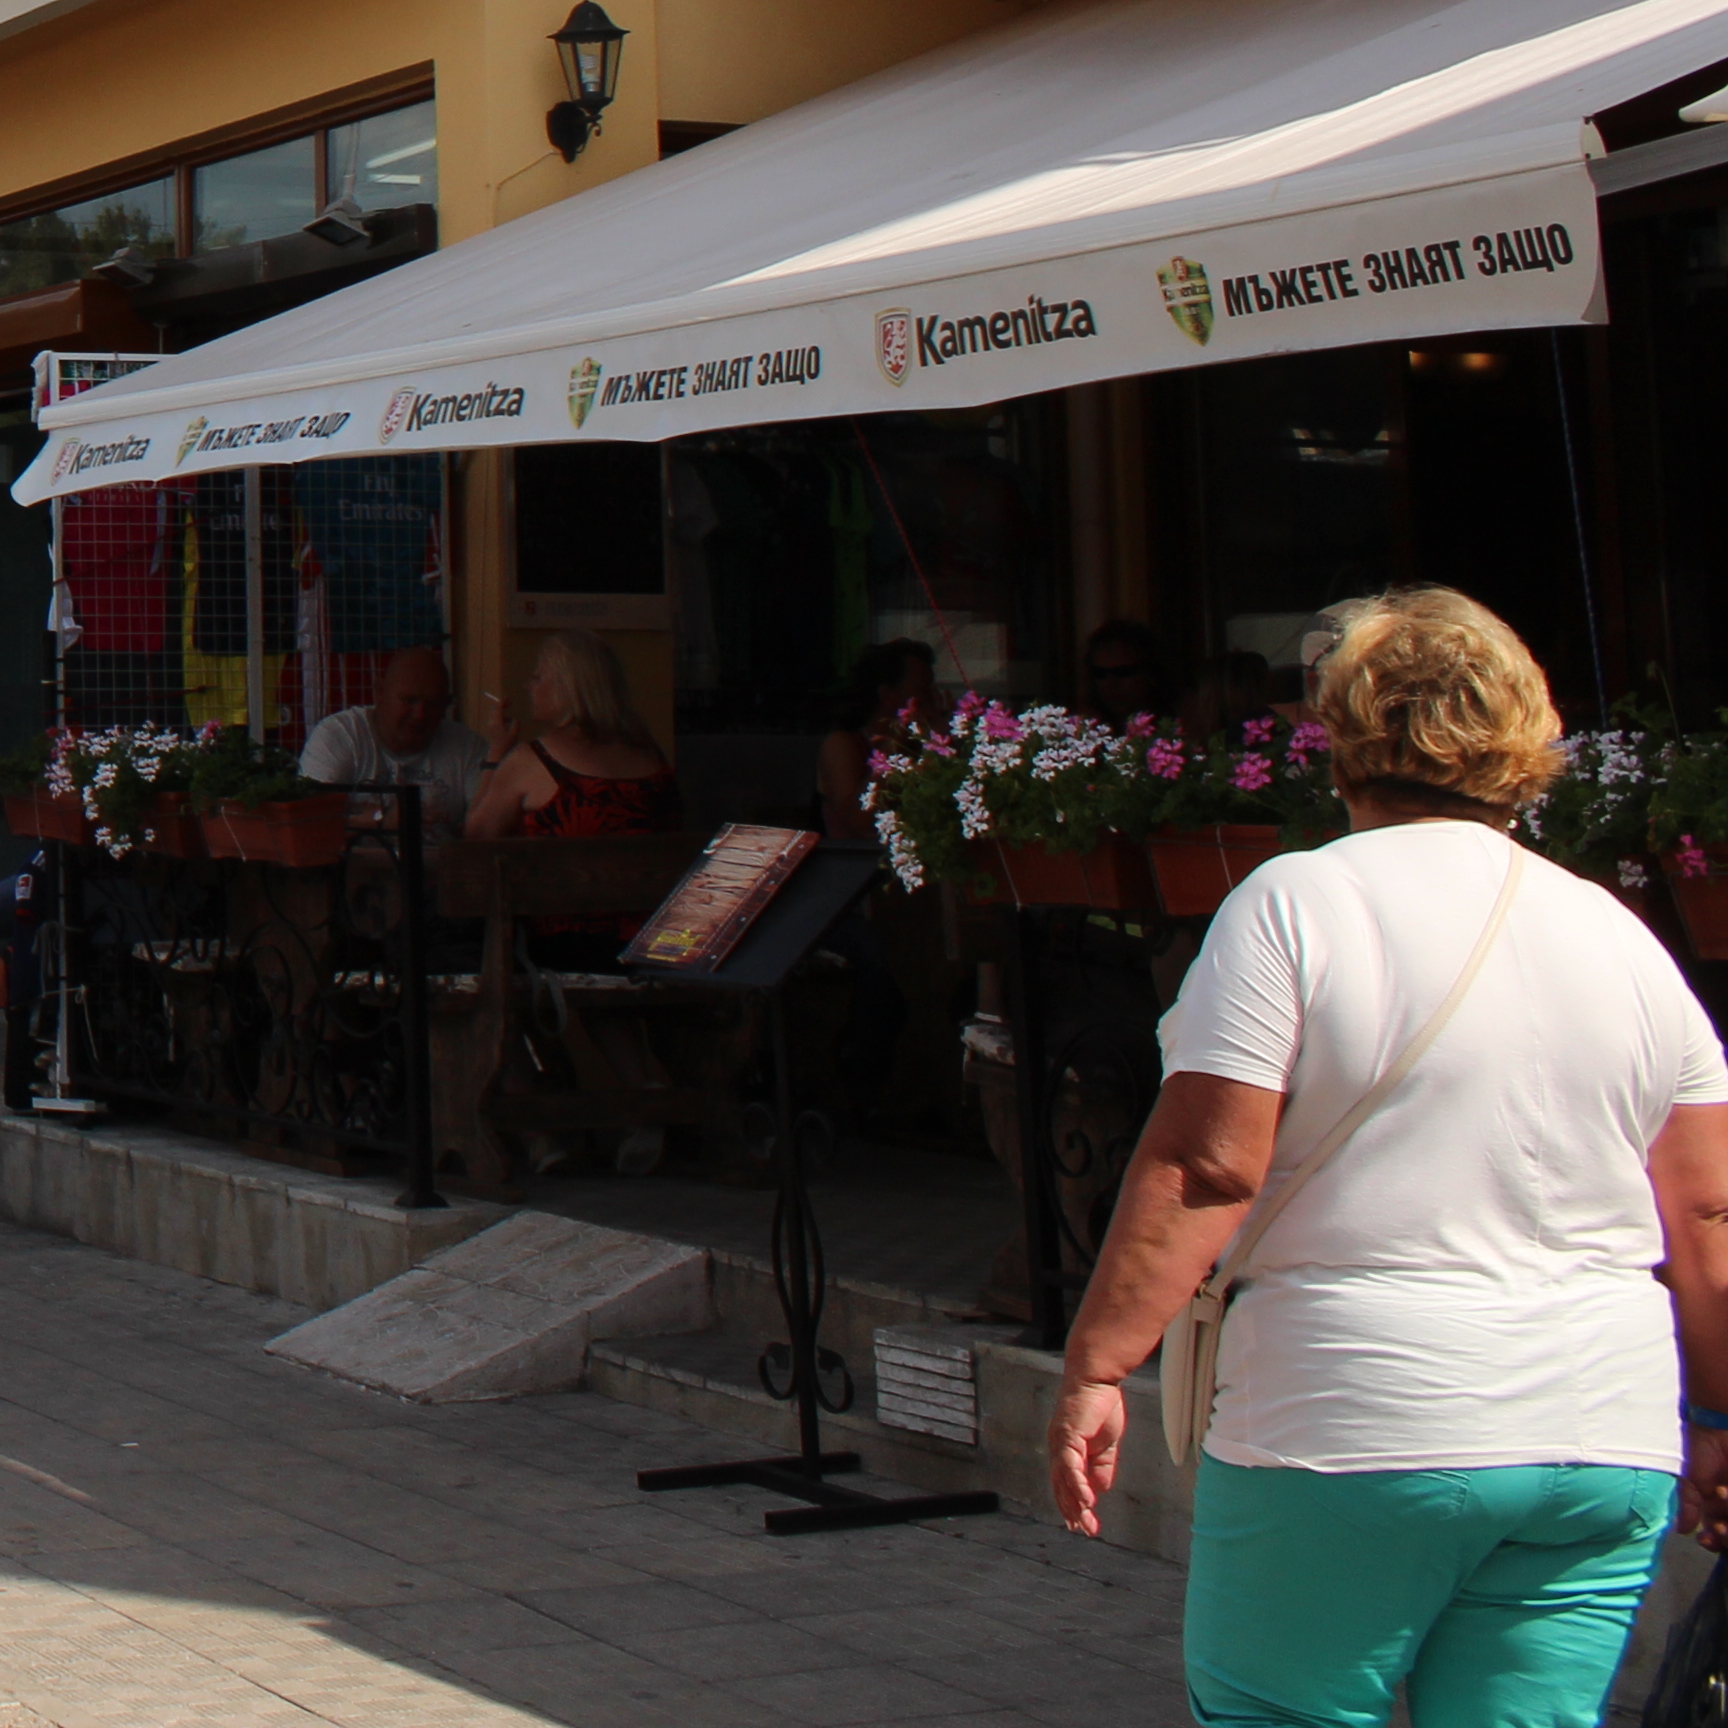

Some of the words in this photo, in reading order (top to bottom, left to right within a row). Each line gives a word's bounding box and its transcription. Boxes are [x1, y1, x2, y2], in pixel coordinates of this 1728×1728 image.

[1221, 259, 1360, 318] МЪЖЕТЕ
[1364, 240, 1467, 295] ЗНАЯТ
[1471, 222, 1574, 276] ЗАЩО
[915, 294, 1097, 368] Kamenitza
[599, 366, 688, 407] МЪЖЕТЕ
[690, 356, 755, 396] ЗНАЯТ
[755, 345, 821, 388] ЗАЩО
[405, 381, 525, 432] Kamenitza
[68, 433, 151, 475] Kamenitza
[196, 423, 263, 453] МЪЖЕТЕ
